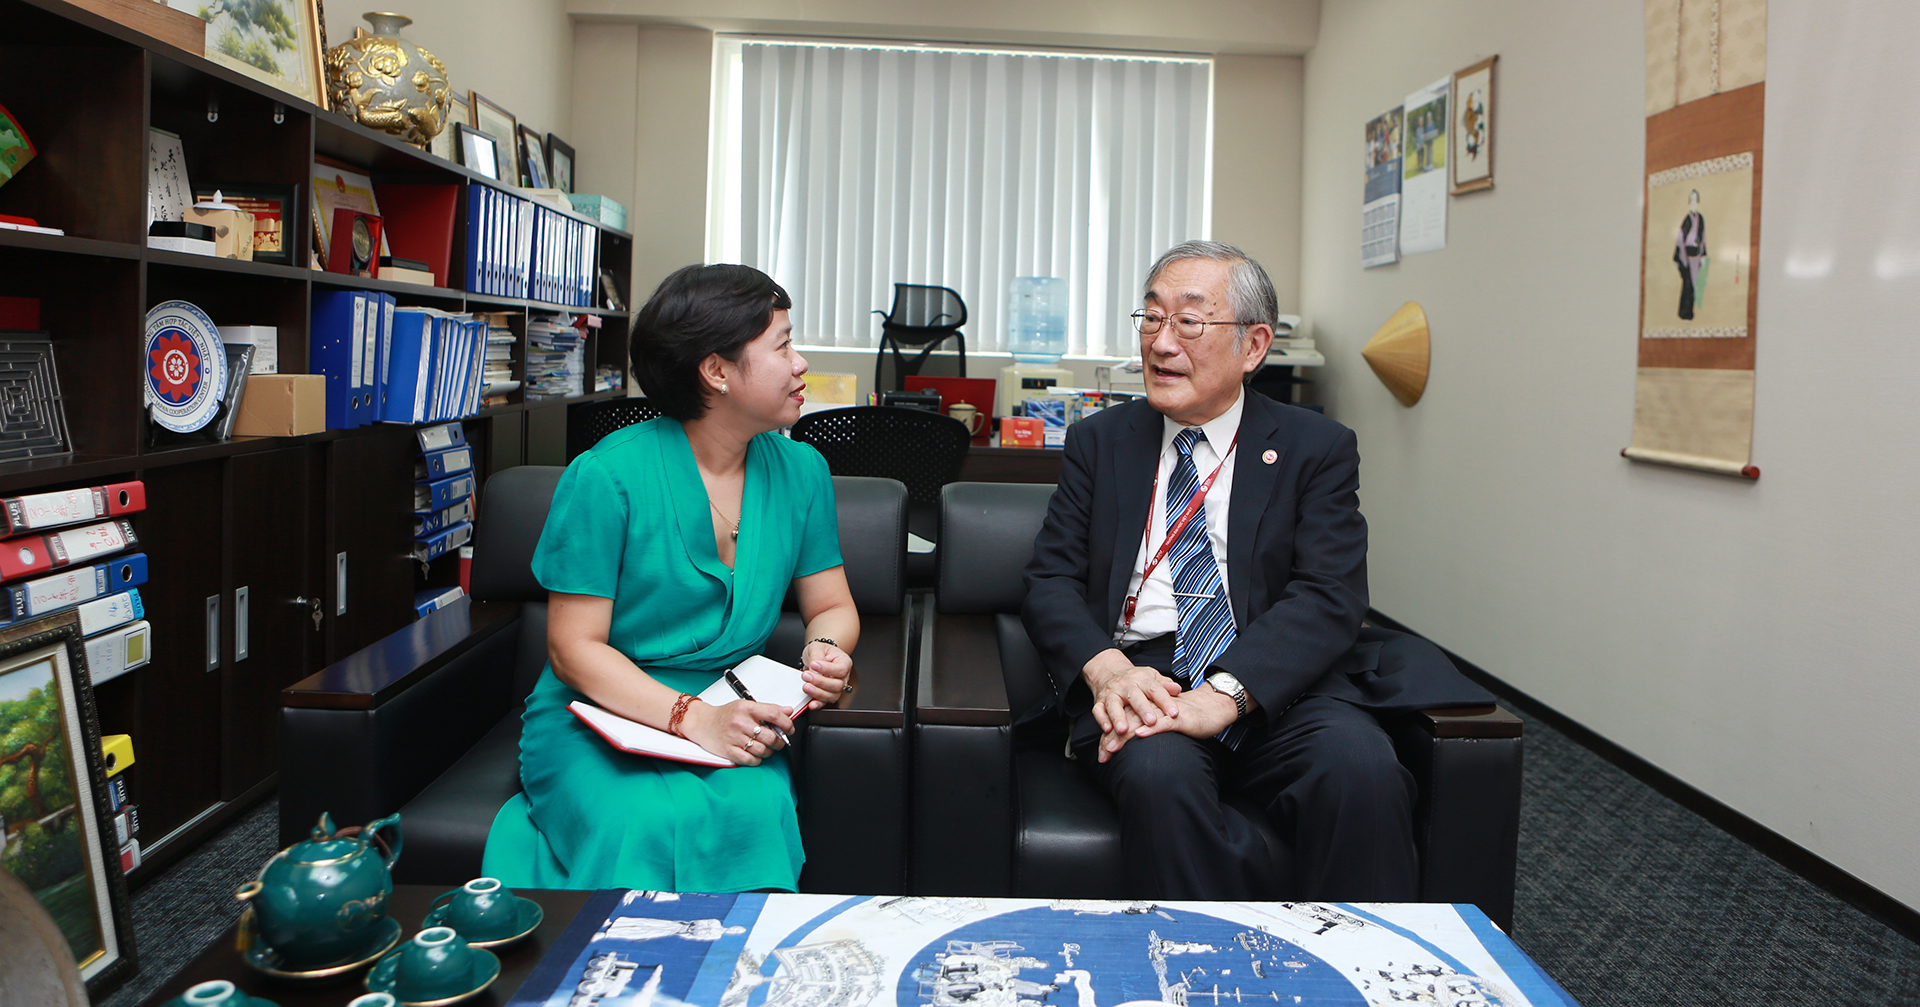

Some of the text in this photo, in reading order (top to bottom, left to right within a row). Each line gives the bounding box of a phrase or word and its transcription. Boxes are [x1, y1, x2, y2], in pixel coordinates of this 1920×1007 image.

[10, 503, 21, 527] PLUS
[122, 521, 136, 542] PLUS
[15, 591, 25, 616] PLUS
[133, 593, 141, 614] PLUS
[117, 780, 126, 803] PLUS
[131, 810, 140, 833] PLUS
